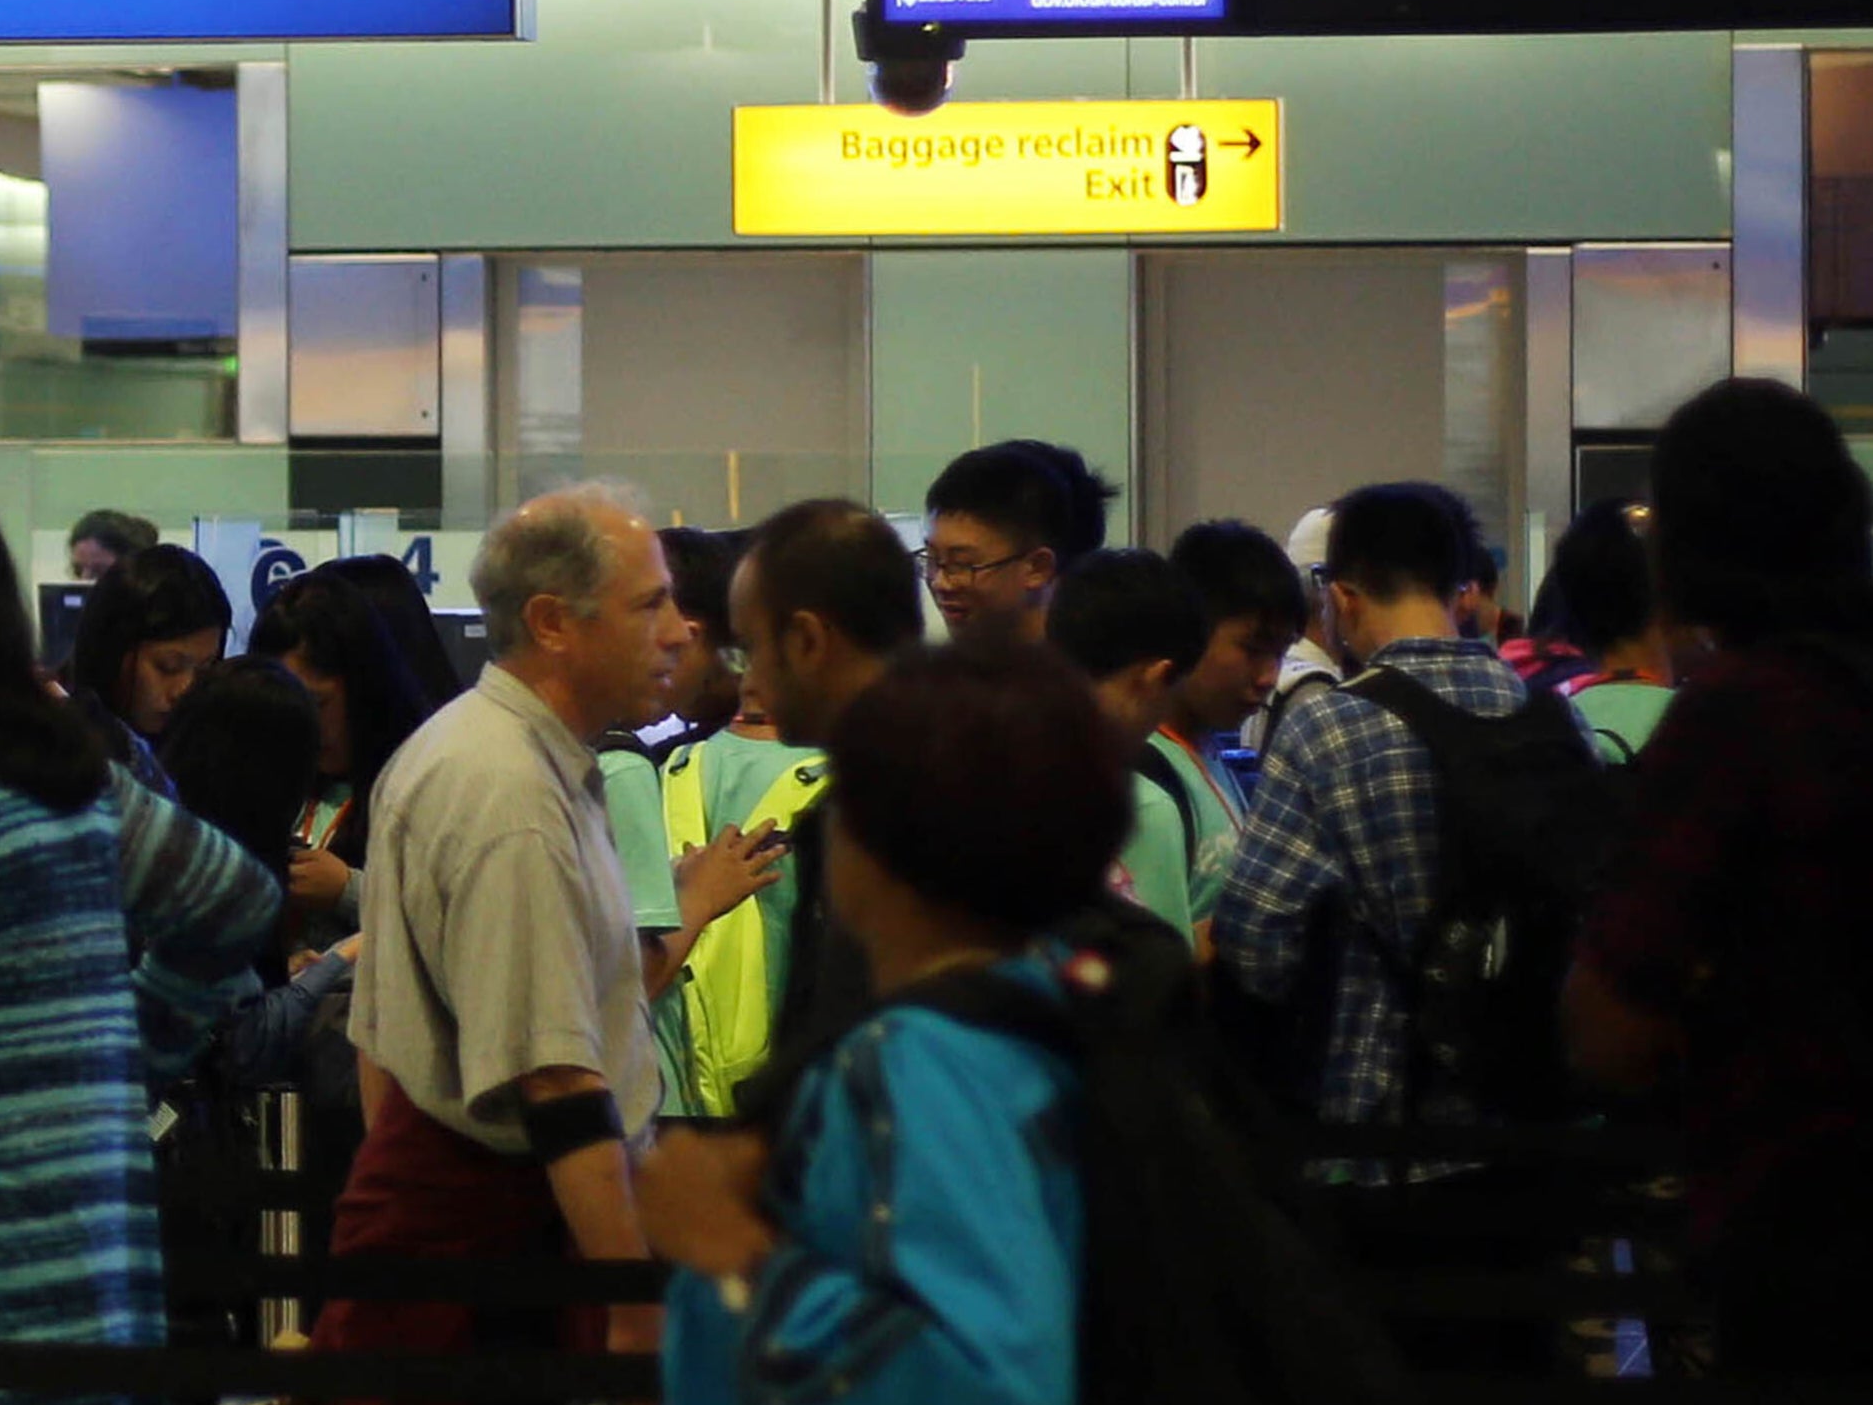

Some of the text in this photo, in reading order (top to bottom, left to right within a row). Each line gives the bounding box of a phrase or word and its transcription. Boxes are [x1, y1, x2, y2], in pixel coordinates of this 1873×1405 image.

[840, 126, 1154, 167] Baggage reclaim
[1085, 168, 1155, 200] Exit
[402, 536, 441, 596] 4
